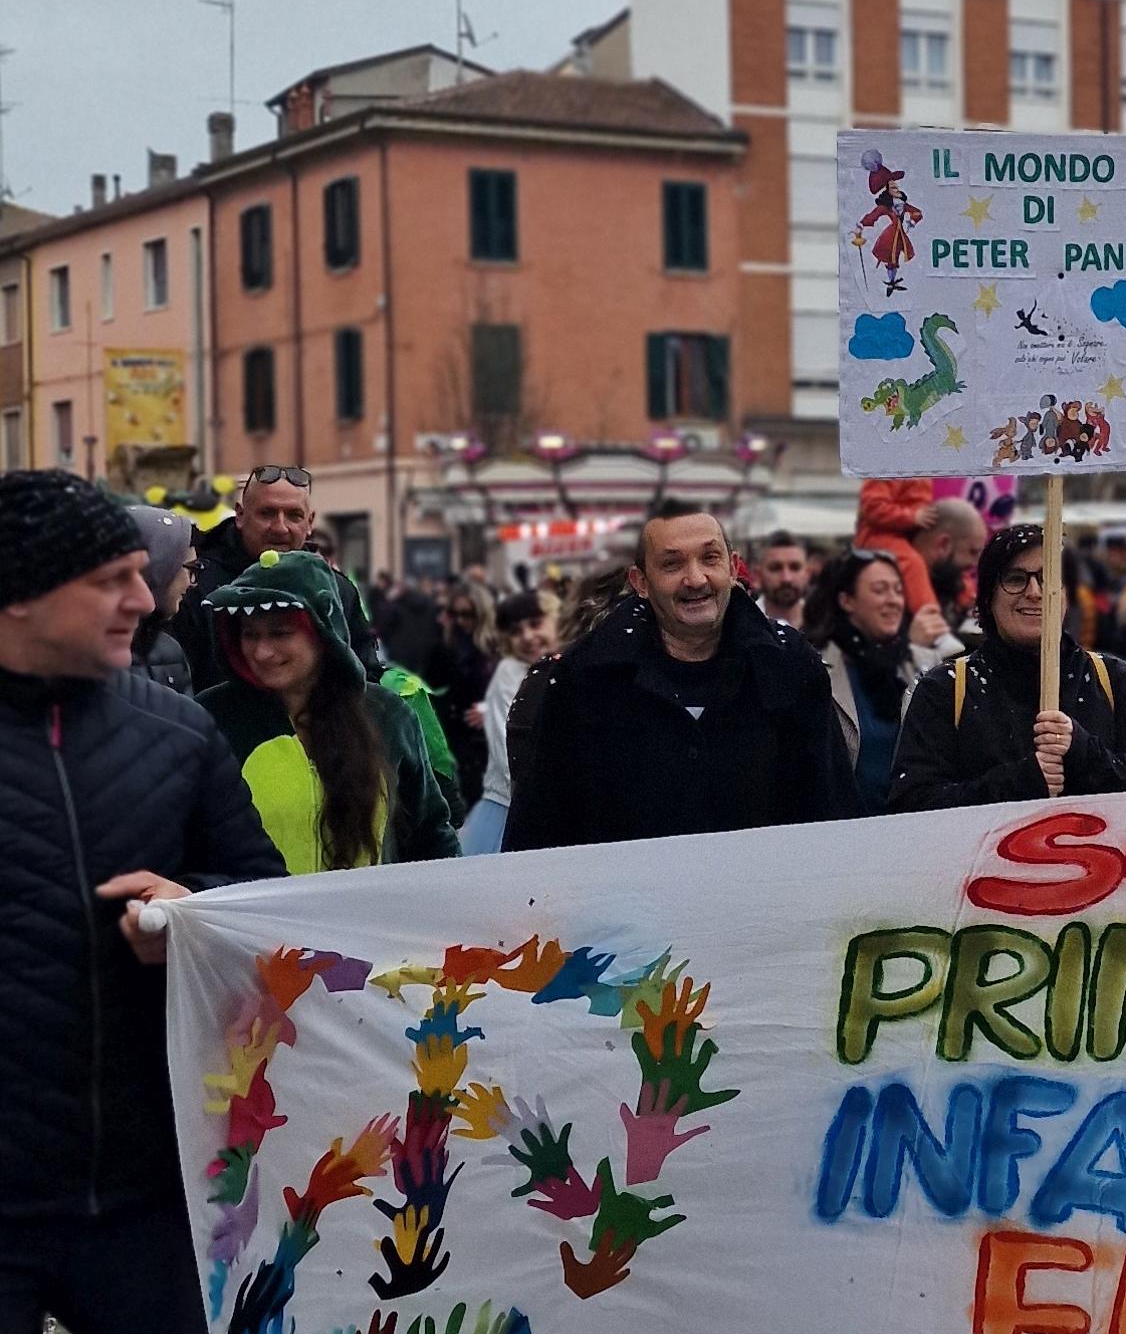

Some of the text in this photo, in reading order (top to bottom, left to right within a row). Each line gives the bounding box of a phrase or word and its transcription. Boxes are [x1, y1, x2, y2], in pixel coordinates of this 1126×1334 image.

[932, 148, 1115, 183] IL MONDO
[1023, 195, 1055, 224] DI
[931, 239, 1124, 271] PETER PAN
